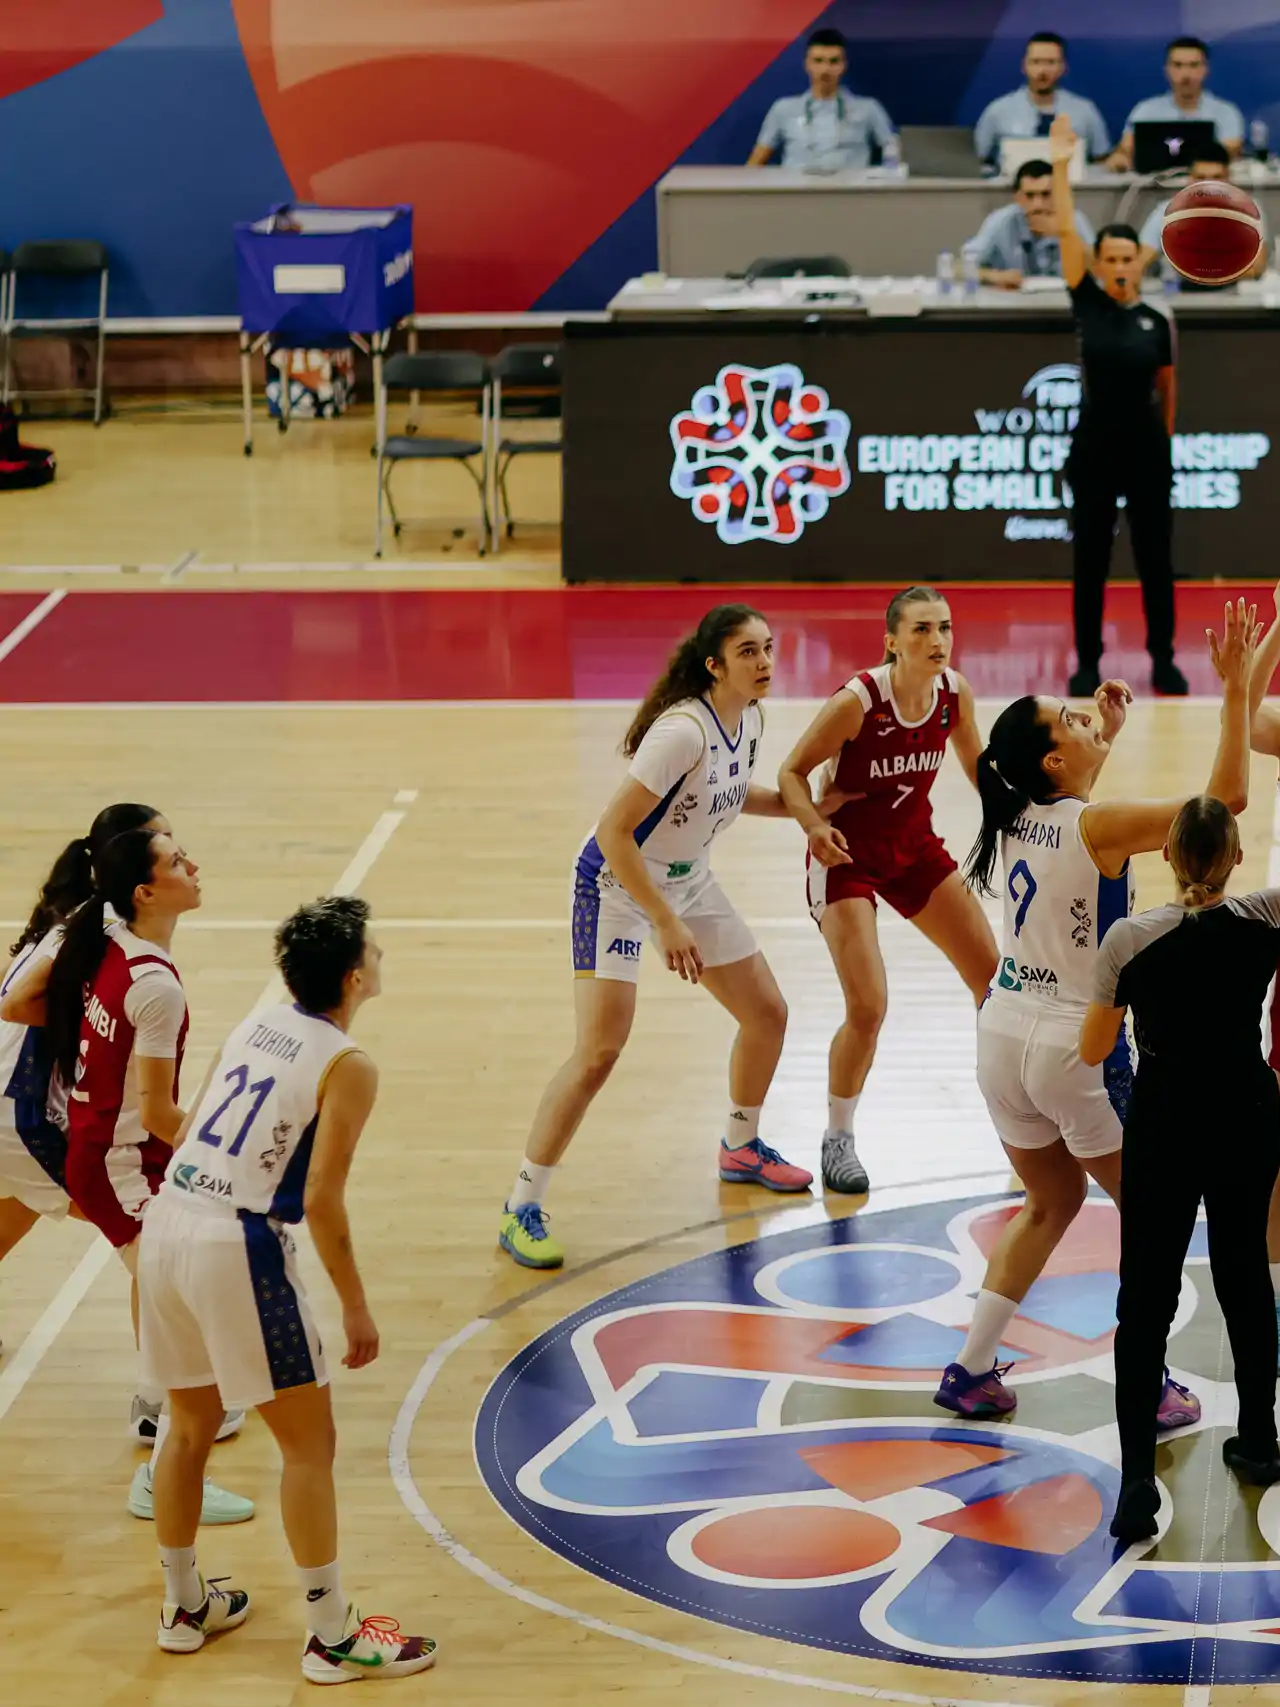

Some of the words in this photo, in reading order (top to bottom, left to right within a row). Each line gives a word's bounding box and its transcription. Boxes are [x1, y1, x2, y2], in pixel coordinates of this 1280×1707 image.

[858, 435, 1025, 473] EUROPEAN
[1028, 433, 1271, 472] CHNSHIP
[885, 473, 949, 511] FOR
[953, 472, 1061, 511] SMALL
[891, 783, 915, 809] 7
[1008, 859, 1037, 939] 9
[1020, 965, 1058, 984] SAVA
[197, 1064, 276, 1157] 21
[194, 1173, 234, 1198] SAVA
